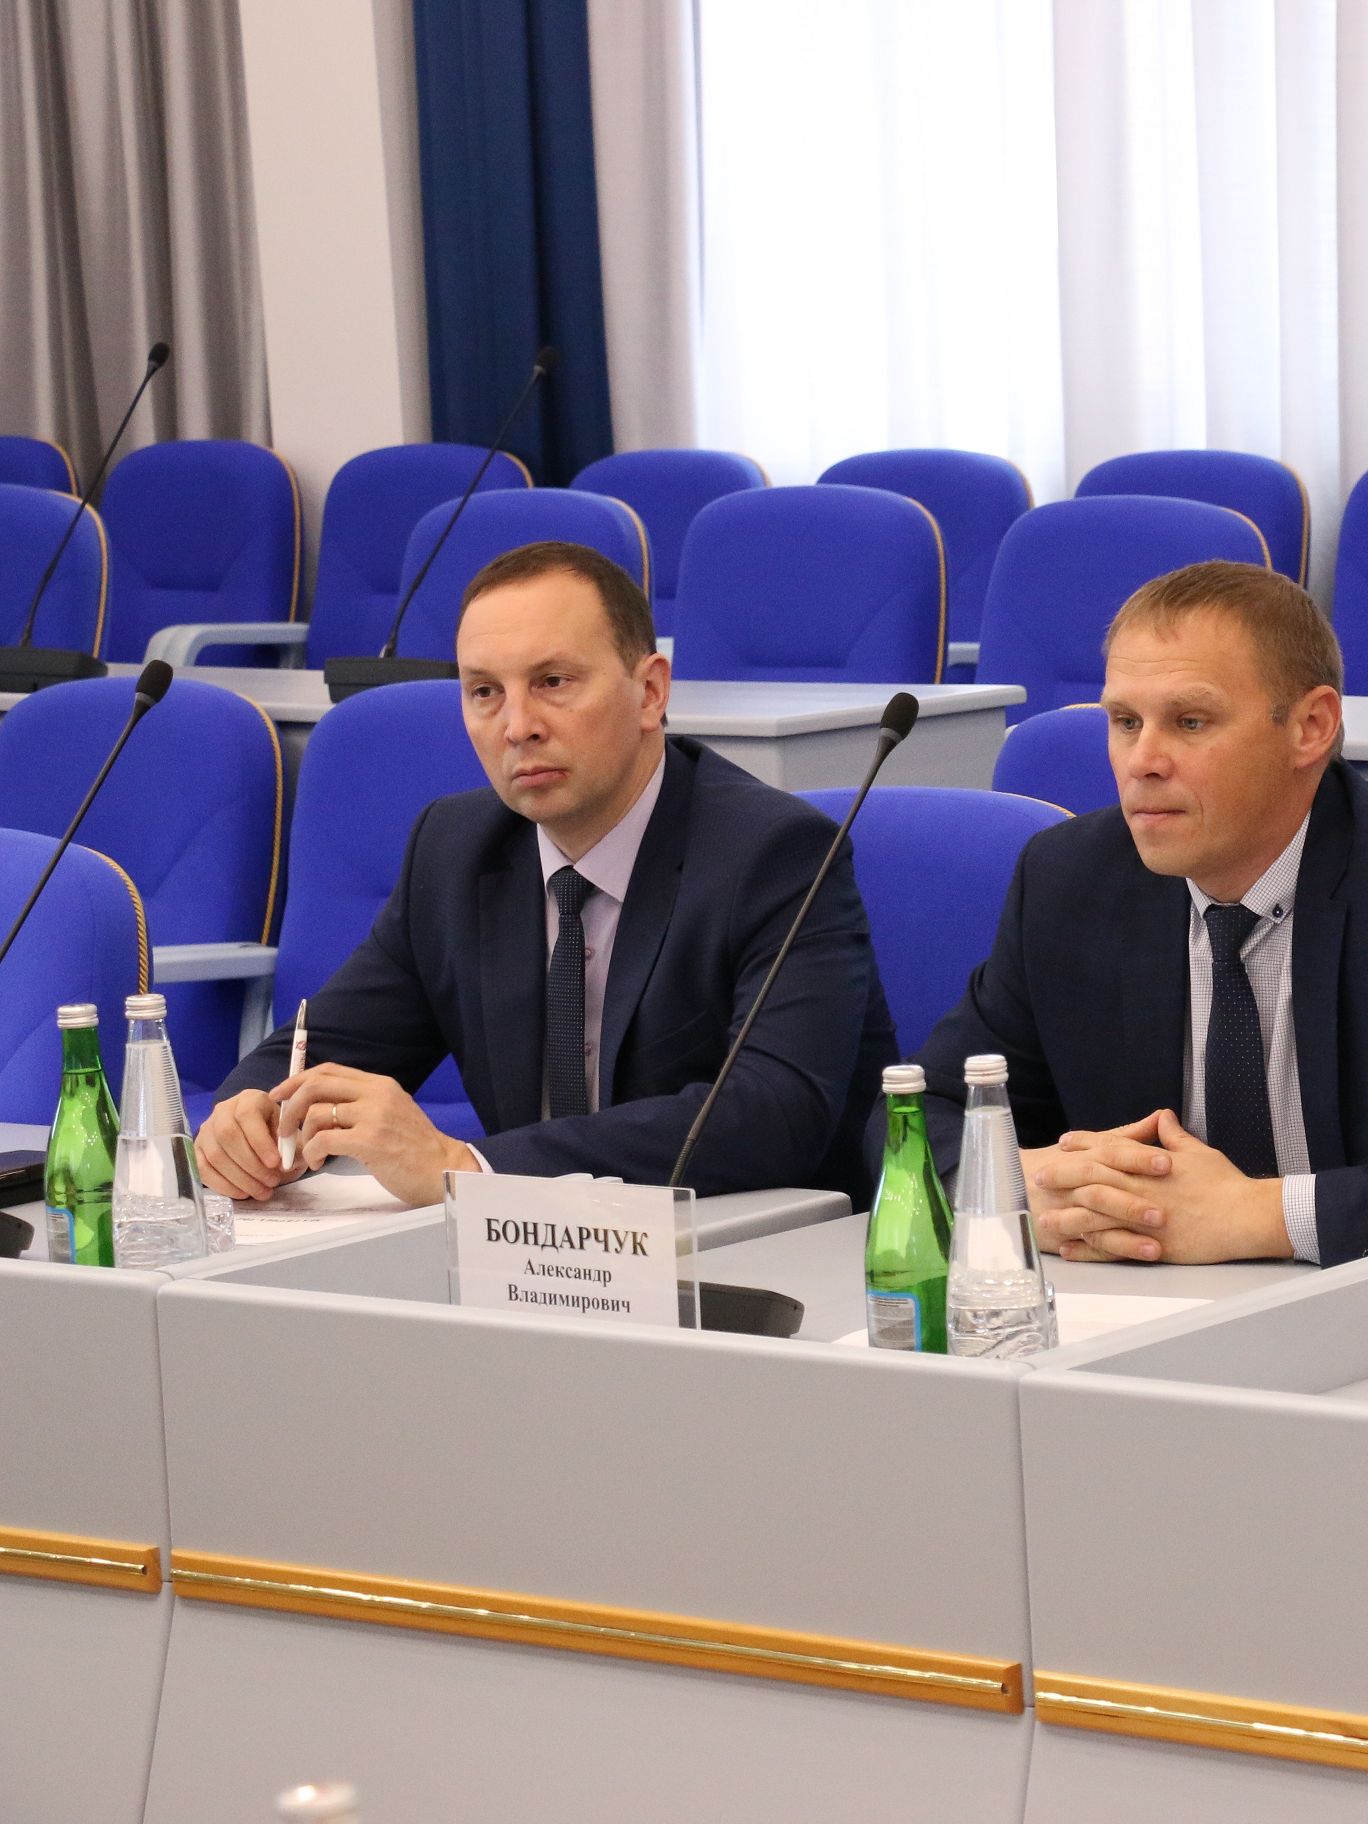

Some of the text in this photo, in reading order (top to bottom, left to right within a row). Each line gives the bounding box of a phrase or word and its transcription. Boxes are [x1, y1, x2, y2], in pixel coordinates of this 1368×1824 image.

[485, 1217, 649, 1257] БОНДАРЧУК
[524, 1258, 612, 1287] Александр
[508, 1284, 631, 1313] Владимирович
